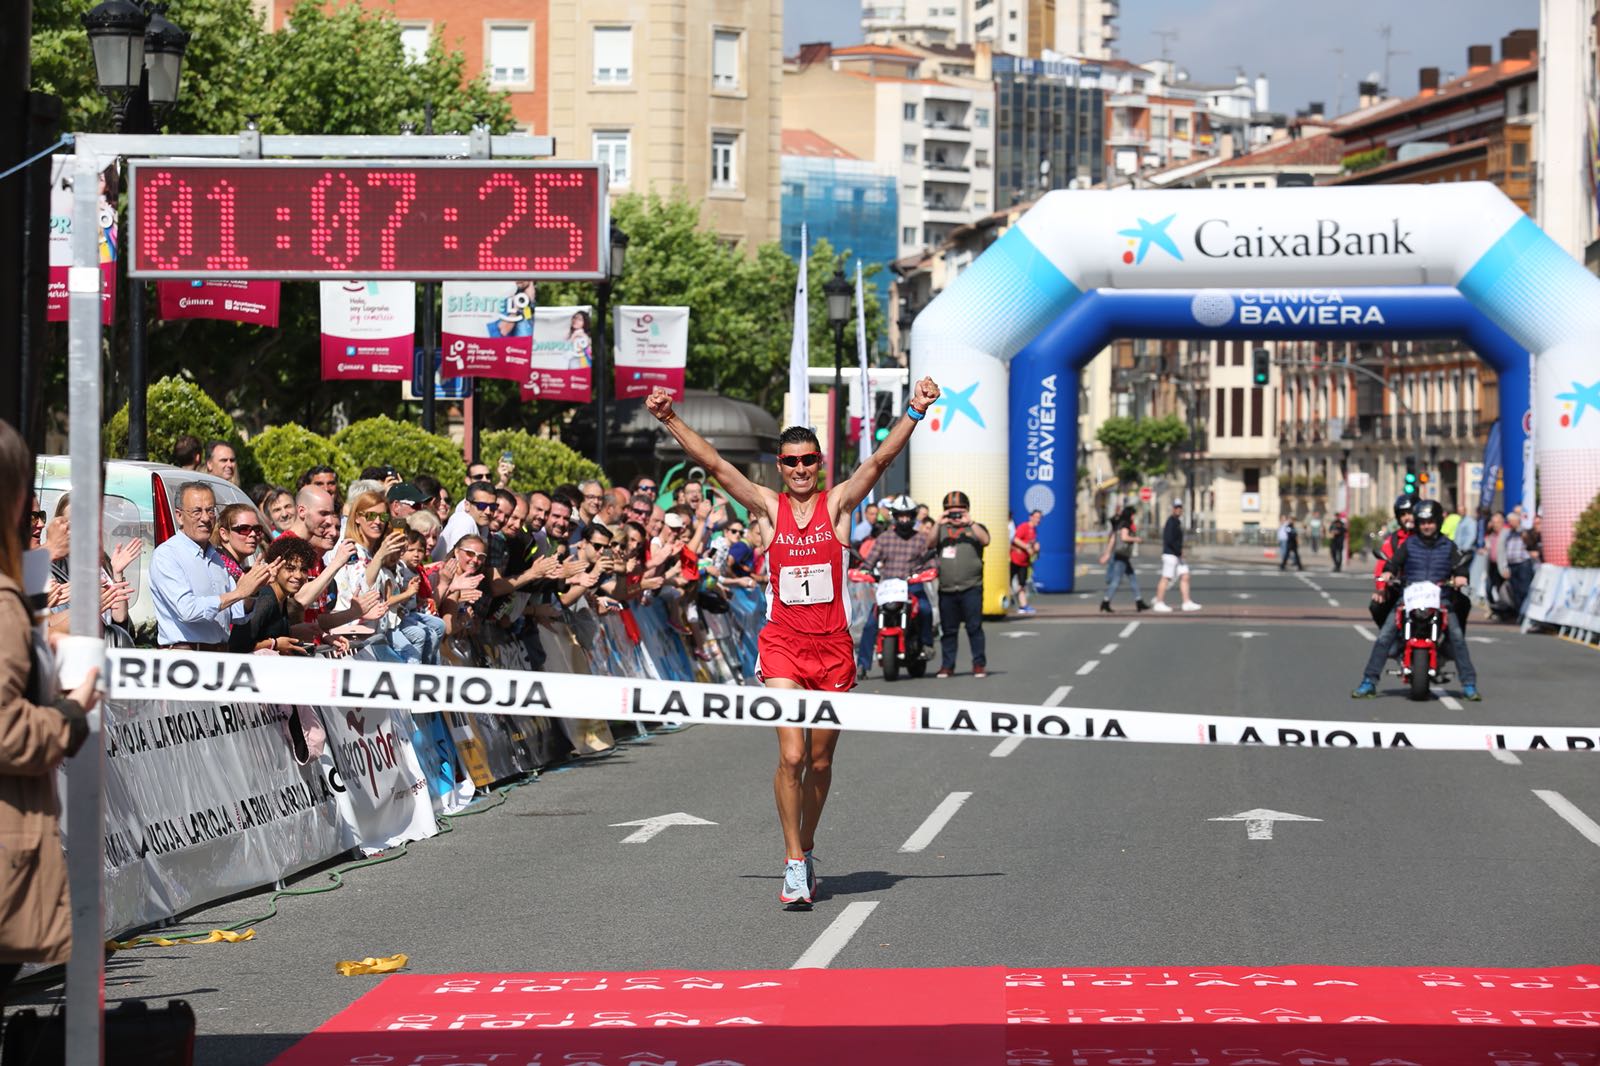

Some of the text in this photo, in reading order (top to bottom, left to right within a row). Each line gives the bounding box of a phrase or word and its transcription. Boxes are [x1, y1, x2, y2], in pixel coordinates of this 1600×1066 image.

[1194, 217, 1416, 258] CaixaBank
[1240, 288, 1344, 305] CLINICA
[1240, 305, 1385, 325] BAVIERA
[1038, 374, 1057, 481] BAVIERA
[1026, 404, 1040, 481] CLINICA
[775, 530, 833, 546] AÑARES
[789, 548, 817, 557] RIOJA
[801, 580, 810, 596] 1
[118, 656, 260, 694] RIOJA
[341, 668, 552, 709] LA RIOJA
[632, 687, 842, 726] LA RIOJA
[921, 706, 1129, 738] LA RIOJA
[434, 982, 783, 993] RIOJANA
[1005, 979, 1360, 987] RIOJANA
[386, 1016, 764, 1030] RIOJANA
[1007, 1015, 1391, 1024] RIOJANA
